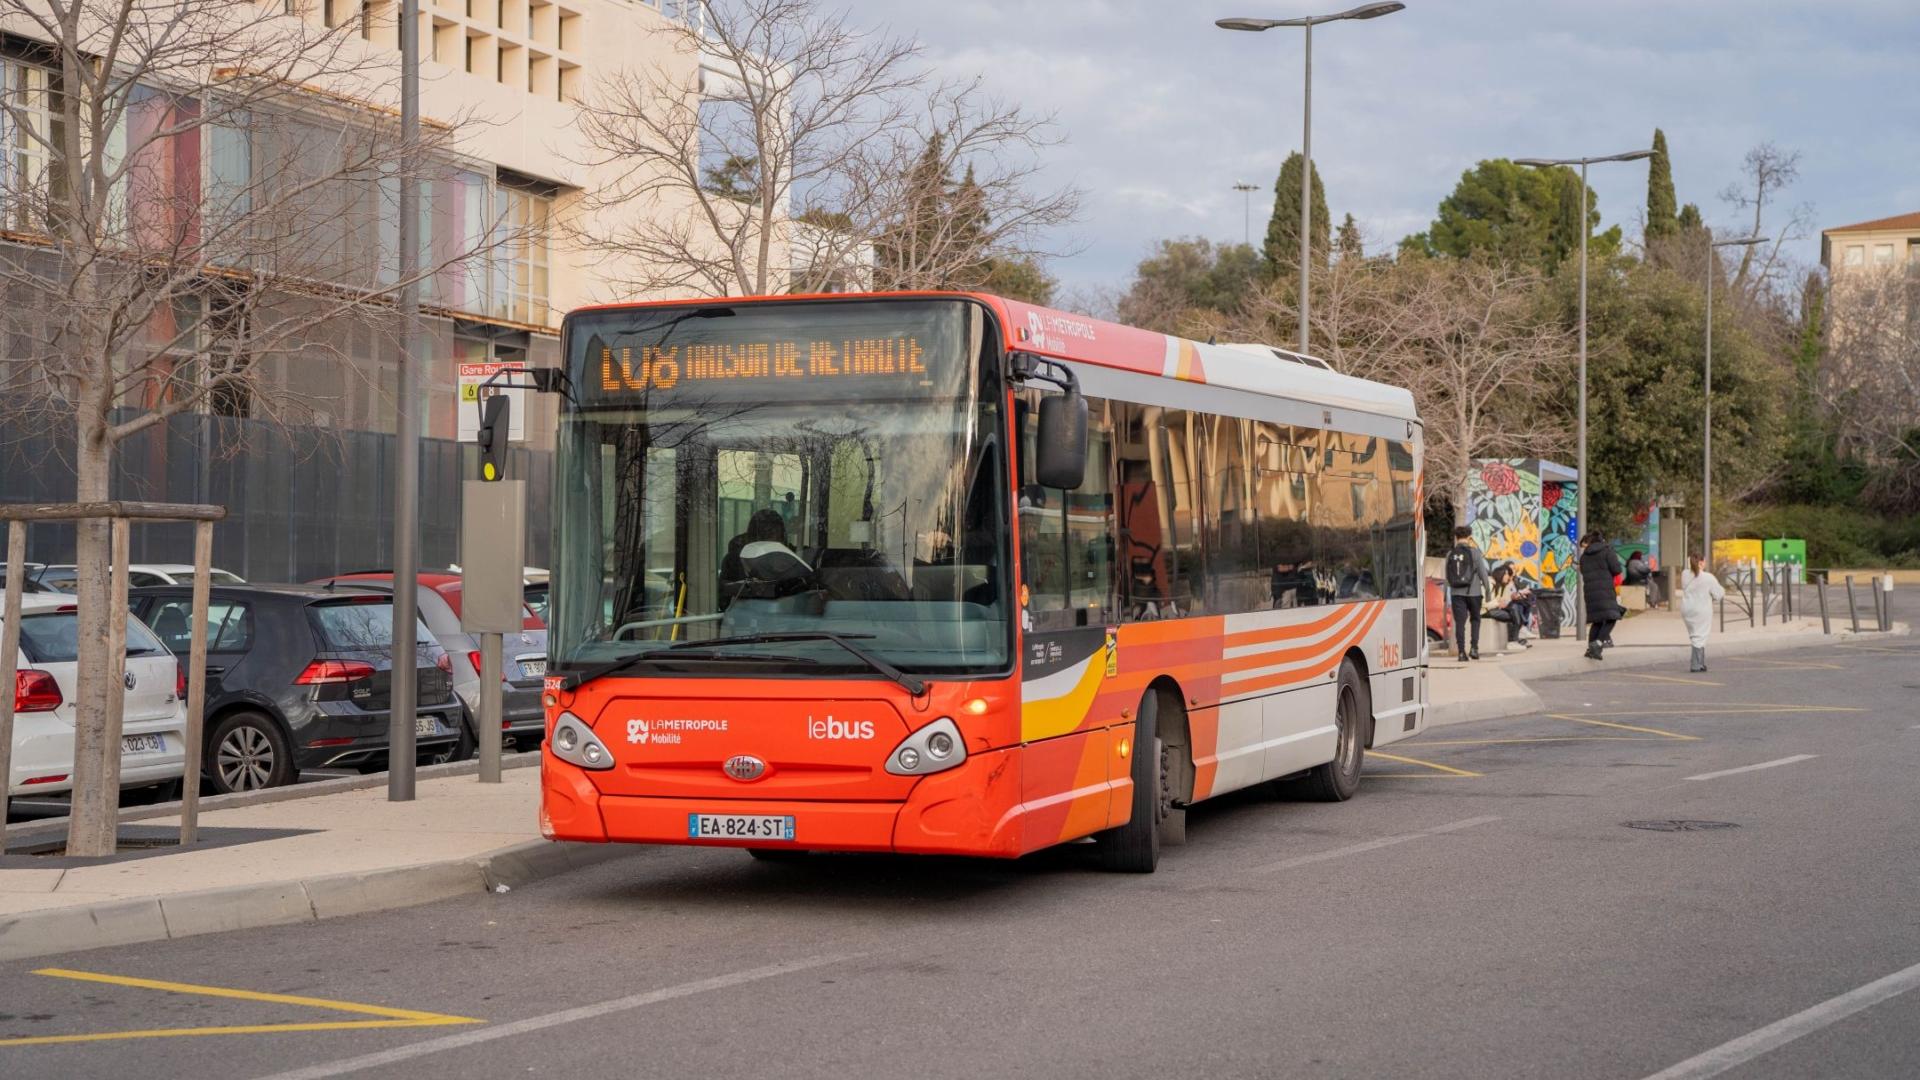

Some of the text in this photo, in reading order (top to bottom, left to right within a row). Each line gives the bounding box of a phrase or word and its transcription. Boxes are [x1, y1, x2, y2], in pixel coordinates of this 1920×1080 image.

[461, 366, 481, 375] Gare
[468, 385, 474, 397] 6
[488, 385, 495, 397] 8
[808, 715, 875, 740] lebus
[651, 733, 681, 744] Mobilité
[701, 817, 783, 836] EA-824-ST
